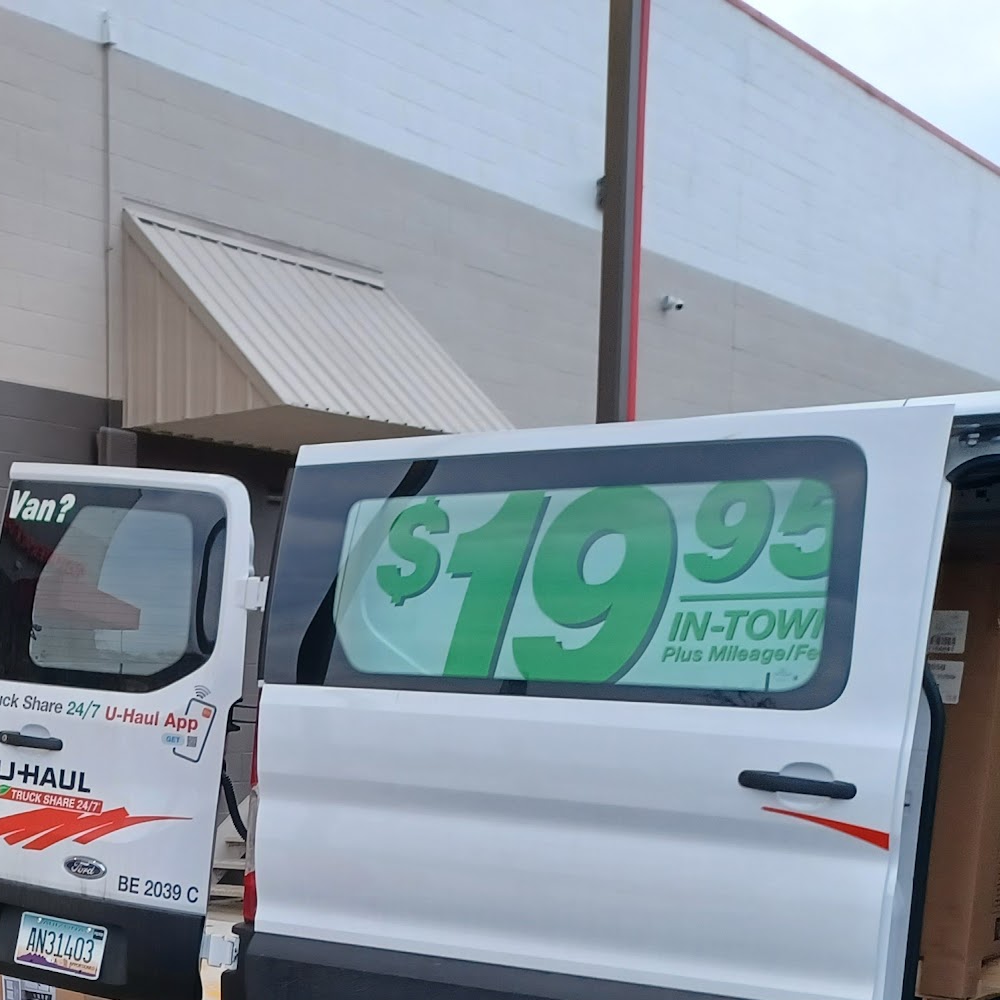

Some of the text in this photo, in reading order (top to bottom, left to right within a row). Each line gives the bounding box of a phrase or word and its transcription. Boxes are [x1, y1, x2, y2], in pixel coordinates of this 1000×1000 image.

[8, 489, 76, 523] Van?
[662, 646, 703, 663] Plus
[22, 695, 63, 713] Share
[66, 701, 100, 720] 24/7
[105, 706, 159, 727] U-Haul
[164, 712, 198, 733] App
[165, 735, 180, 744] GET
[11, 789, 100, 812] TRUCK SHARE 24/7
[71, 861, 96, 877] Ford
[118, 875, 199, 903] BE 2039 C
[26, 927, 95, 964] AN31403
